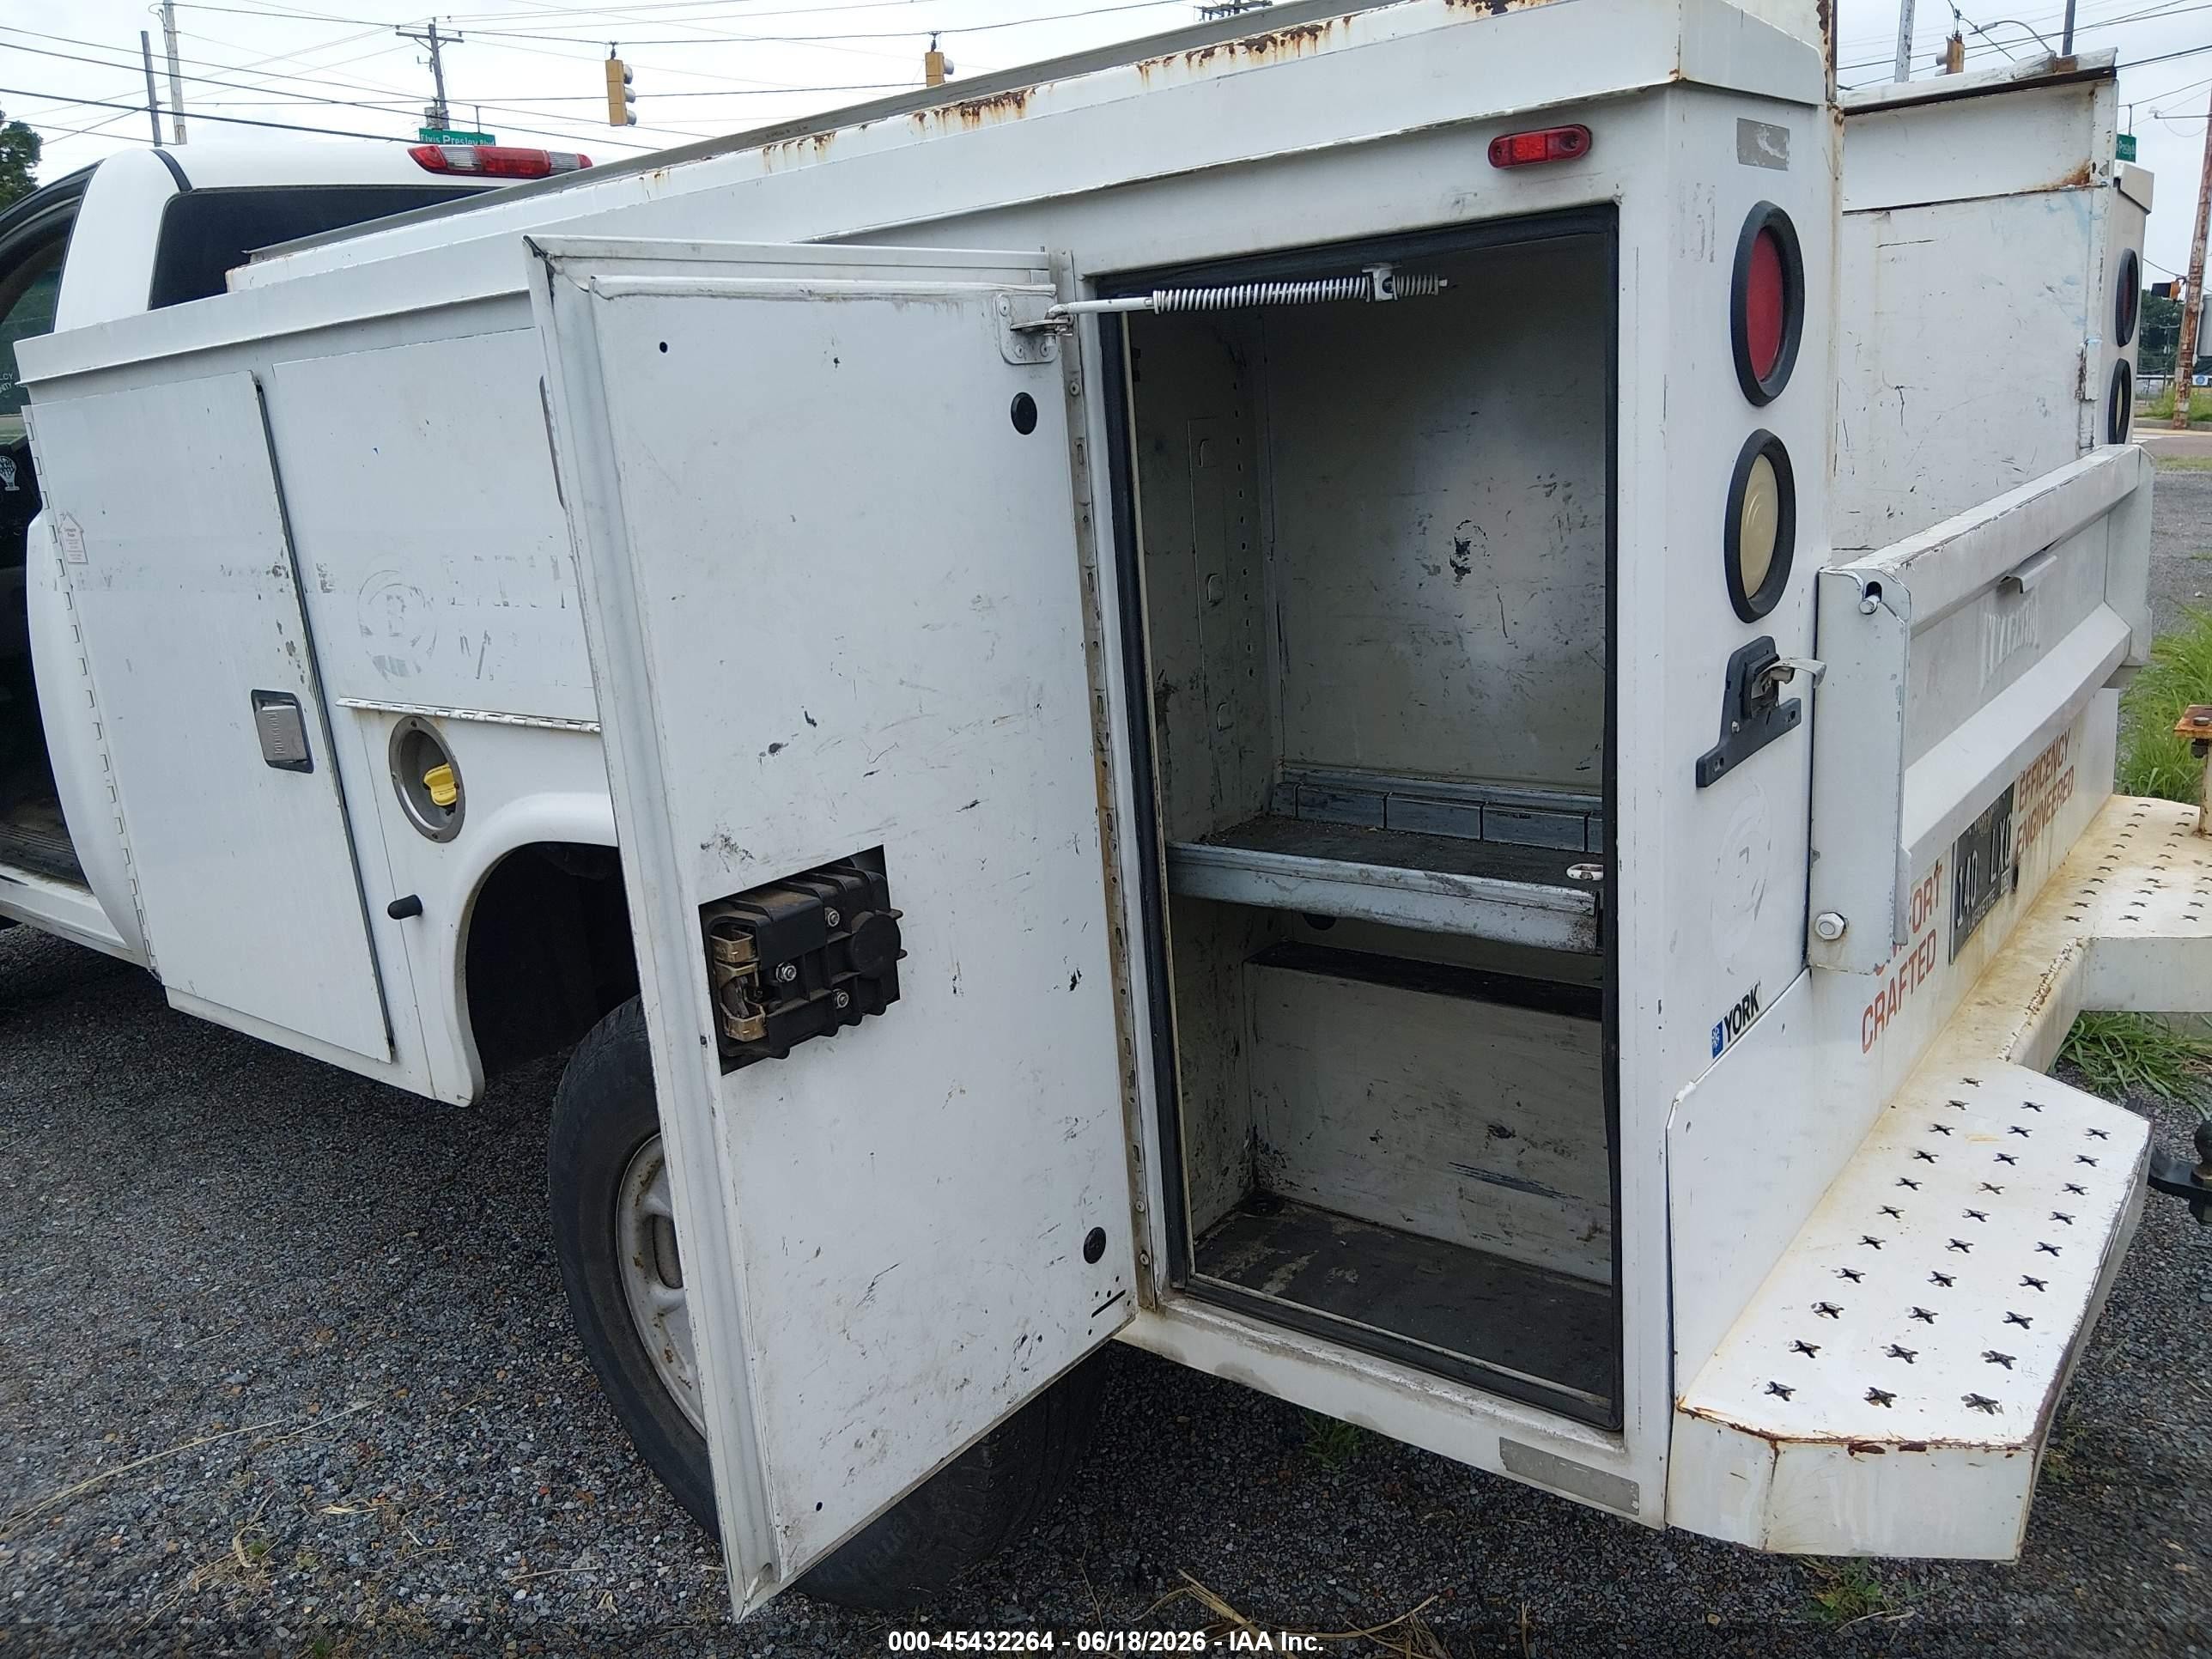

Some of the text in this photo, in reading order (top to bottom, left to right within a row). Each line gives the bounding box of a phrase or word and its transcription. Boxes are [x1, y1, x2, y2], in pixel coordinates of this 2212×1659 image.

[420, 134, 441, 143] Elvis
[442, 135, 477, 145] Presley
[2017, 764, 2075, 856] ENGINEERED
[1908, 863, 1943, 934] ORT
[1957, 848, 1978, 928] 140
[1723, 983, 1759, 1043] YORK
[1862, 927, 1936, 1054] CRAFTED
